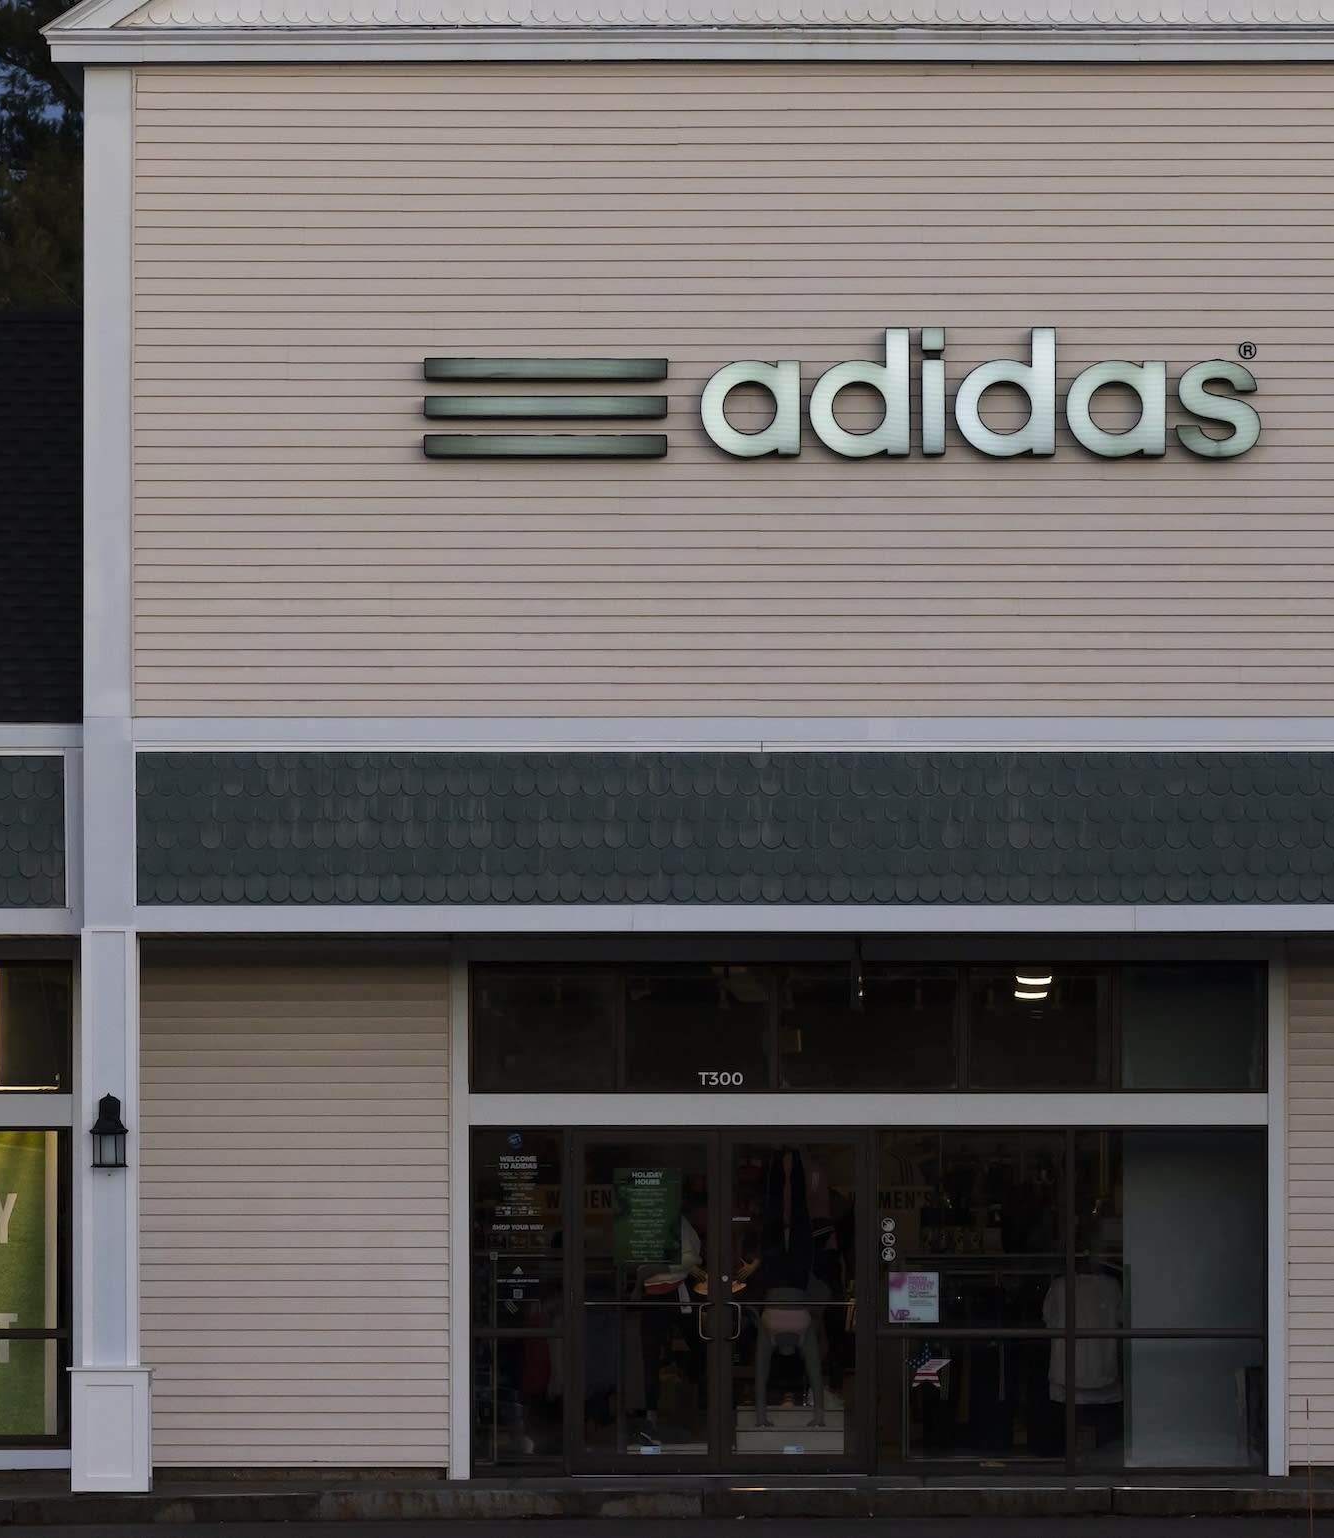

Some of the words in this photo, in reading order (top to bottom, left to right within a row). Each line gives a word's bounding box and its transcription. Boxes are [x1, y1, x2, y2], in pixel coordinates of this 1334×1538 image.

[699, 327, 1262, 459] adidas
[698, 1071, 744, 1086] T300
[498, 1155, 538, 1163] WELCOME
[631, 1171, 663, 1179] HOLIDAY
[511, 1223, 529, 1231] YOUR
